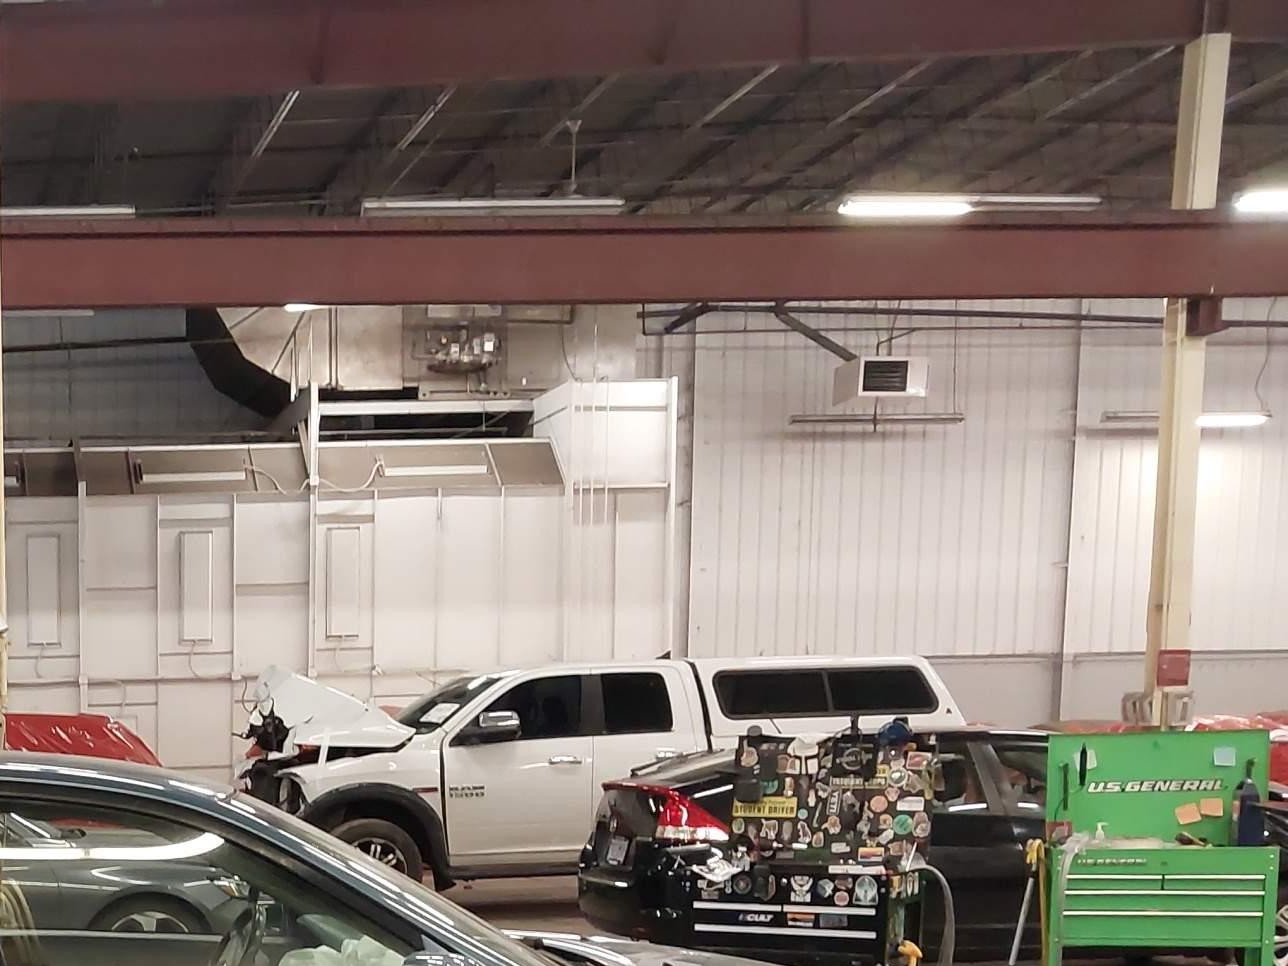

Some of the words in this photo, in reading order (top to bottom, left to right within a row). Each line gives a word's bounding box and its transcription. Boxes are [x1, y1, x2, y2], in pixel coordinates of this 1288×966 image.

[734, 804, 766, 814] STUDENT
[768, 804, 795, 814] DRIVER
[828, 790, 840, 813] YETI
